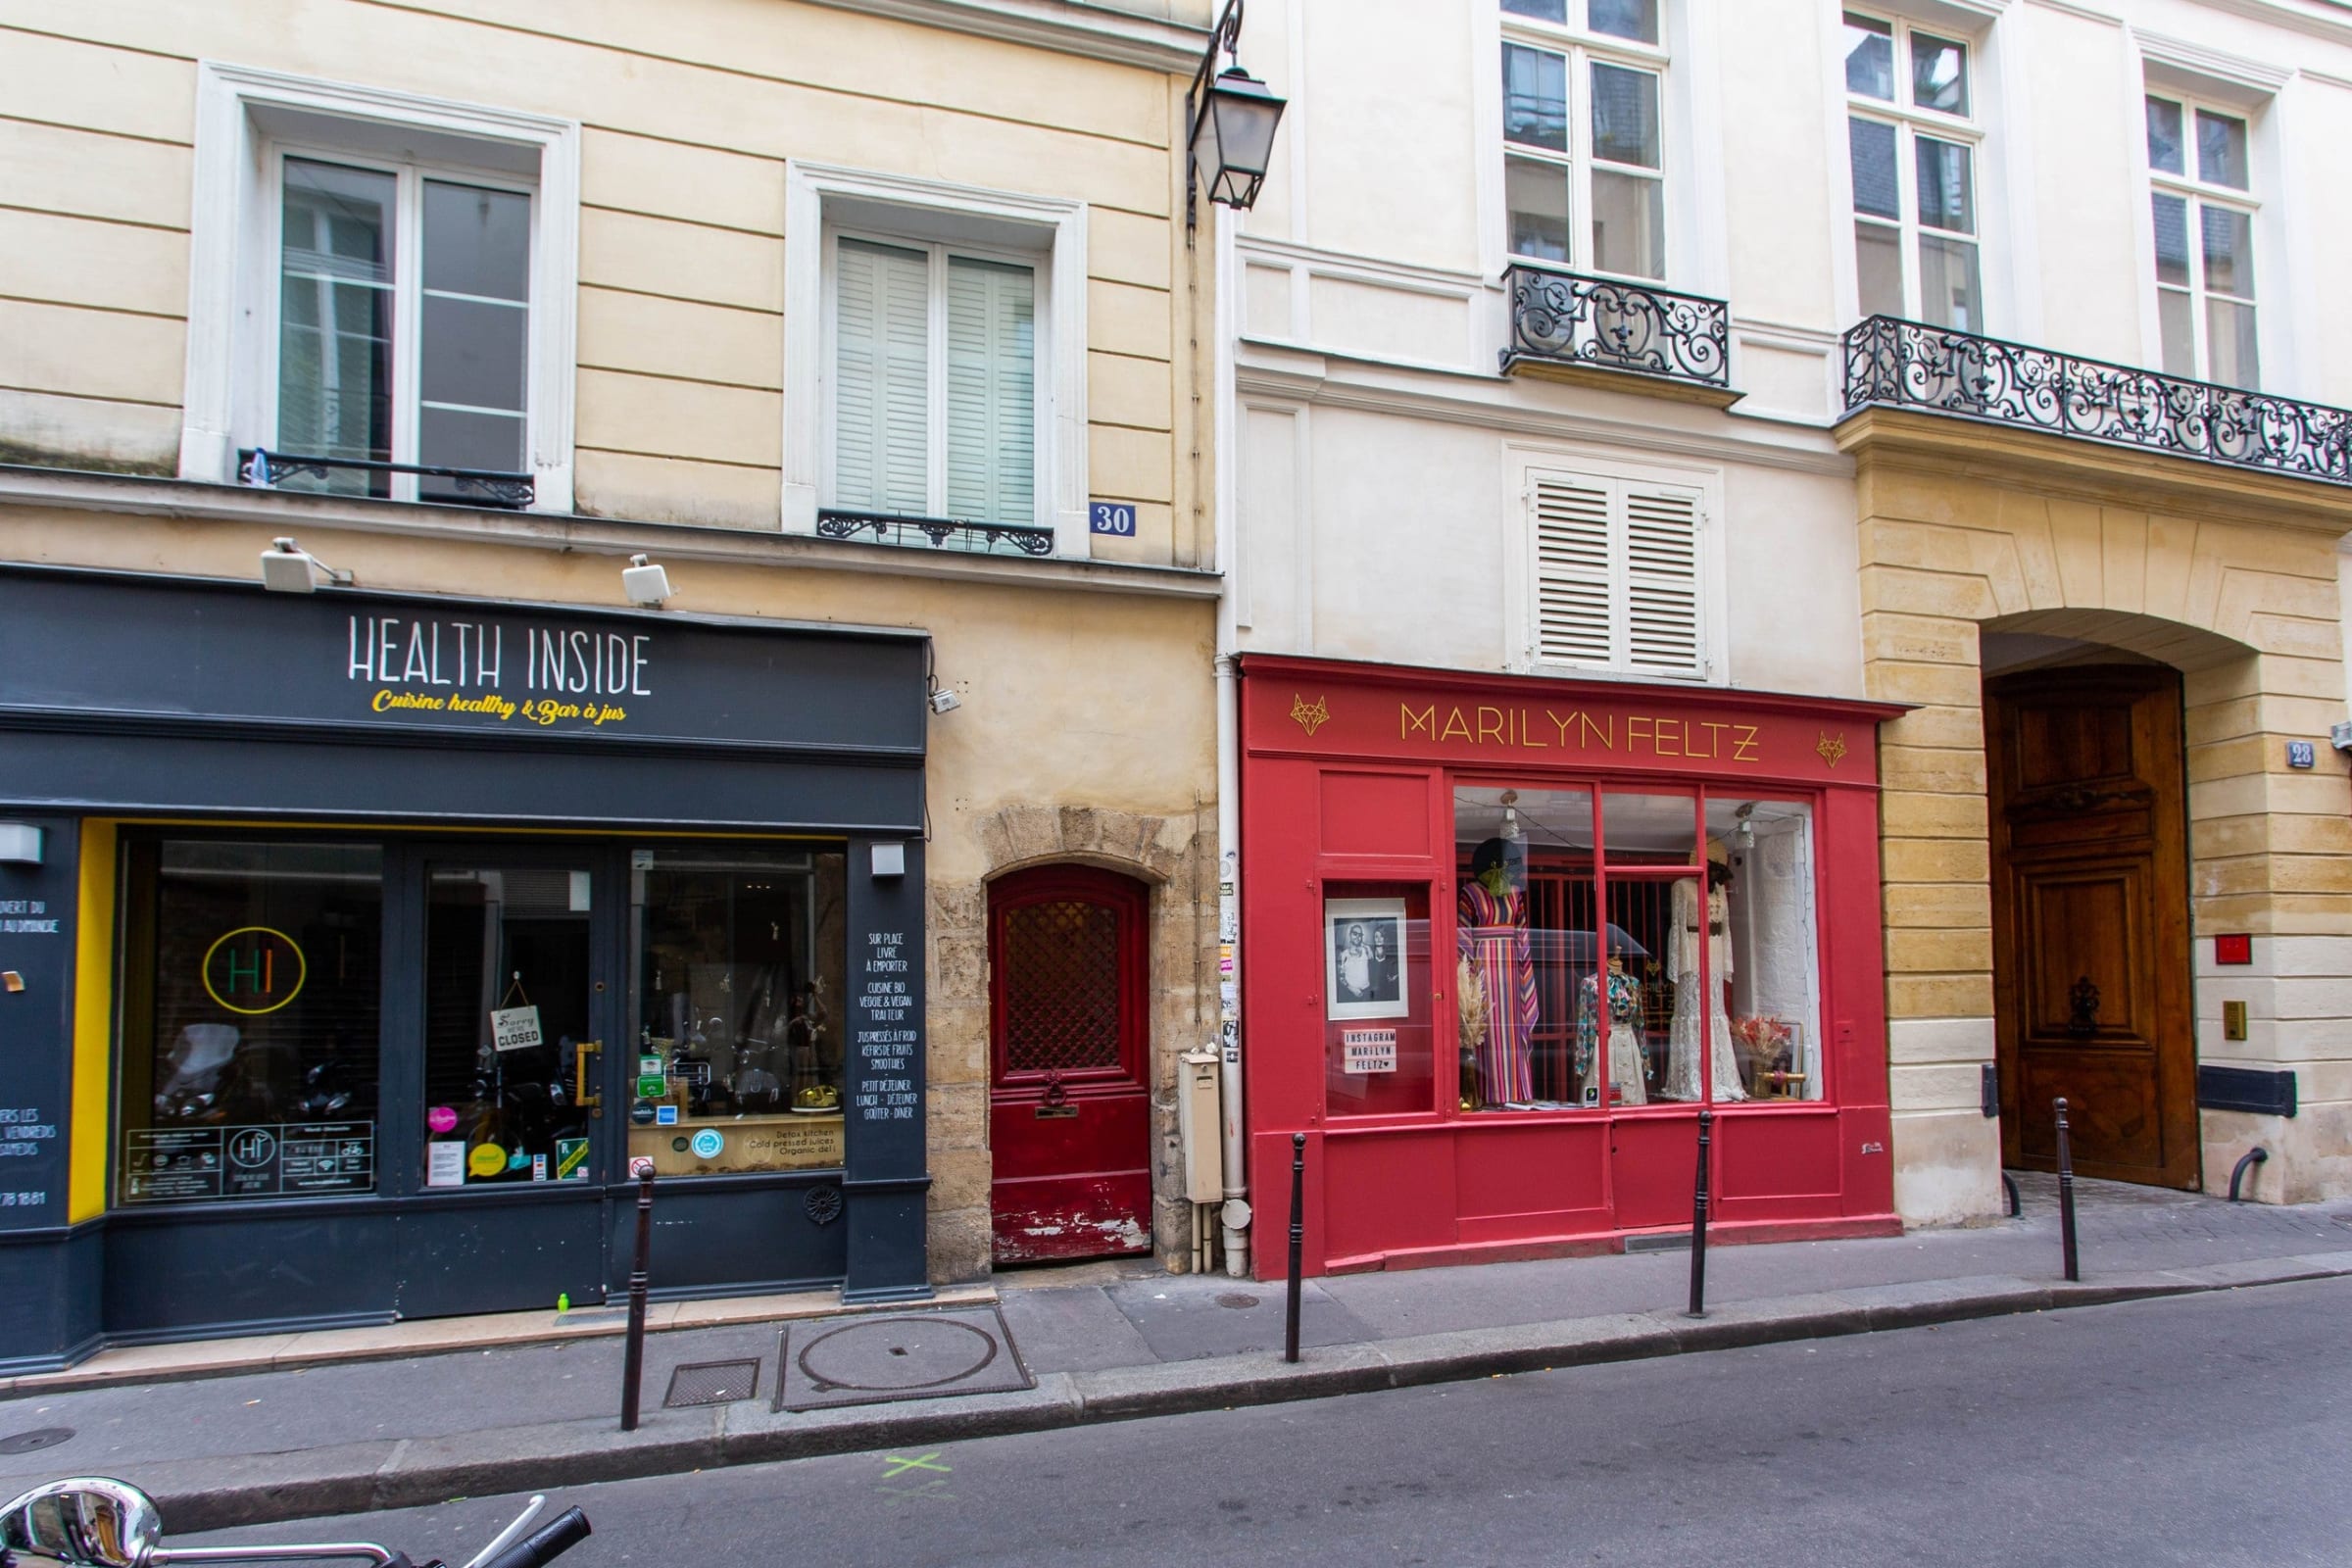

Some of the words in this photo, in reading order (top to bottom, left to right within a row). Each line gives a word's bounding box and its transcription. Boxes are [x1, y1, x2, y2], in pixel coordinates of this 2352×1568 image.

[1097, 506, 1130, 533] 30
[348, 615, 501, 688] HEALTH
[528, 627, 652, 696] INSIDE
[371, 689, 445, 712] Cuisine
[447, 693, 516, 720] healthy
[537, 699, 580, 725] Bar
[594, 706, 627, 725] jus
[1400, 703, 1613, 750] MARILYN
[1628, 715, 1759, 761] FELTZ
[2292, 744, 2312, 762] 28
[868, 933, 882, 945] SUR
[883, 933, 904, 945] PLACE
[229, 948, 273, 994] HI
[872, 960, 908, 972] EMPORTER
[867, 982, 893, 994] CUISINE
[894, 982, 906, 994] BIO
[858, 996, 882, 1007] VEGGIE
[890, 996, 912, 1006] VEGAN
[498, 1012, 534, 1029] Sorry
[870, 1009, 905, 1021] TRAITEUR
[498, 1030, 539, 1047] CLOSED
[858, 1031, 869, 1043] JUS
[899, 1030, 917, 1042] FROID
[1346, 1032, 1396, 1043] INSTAGRAM
[882, 1045, 891, 1056] DE
[892, 1045, 913, 1055] FRUITS
[870, 1058, 906, 1070] SMOOTHIES
[861, 1080, 879, 1092] PETIT
[856, 1094, 878, 1106] LUNCH
[776, 1130, 801, 1139] Detox
[561, 1143, 568, 1153] R
[750, 1140, 770, 1149] Cold
[773, 1138, 808, 1149] pressed
[809, 1138, 835, 1147] juices
